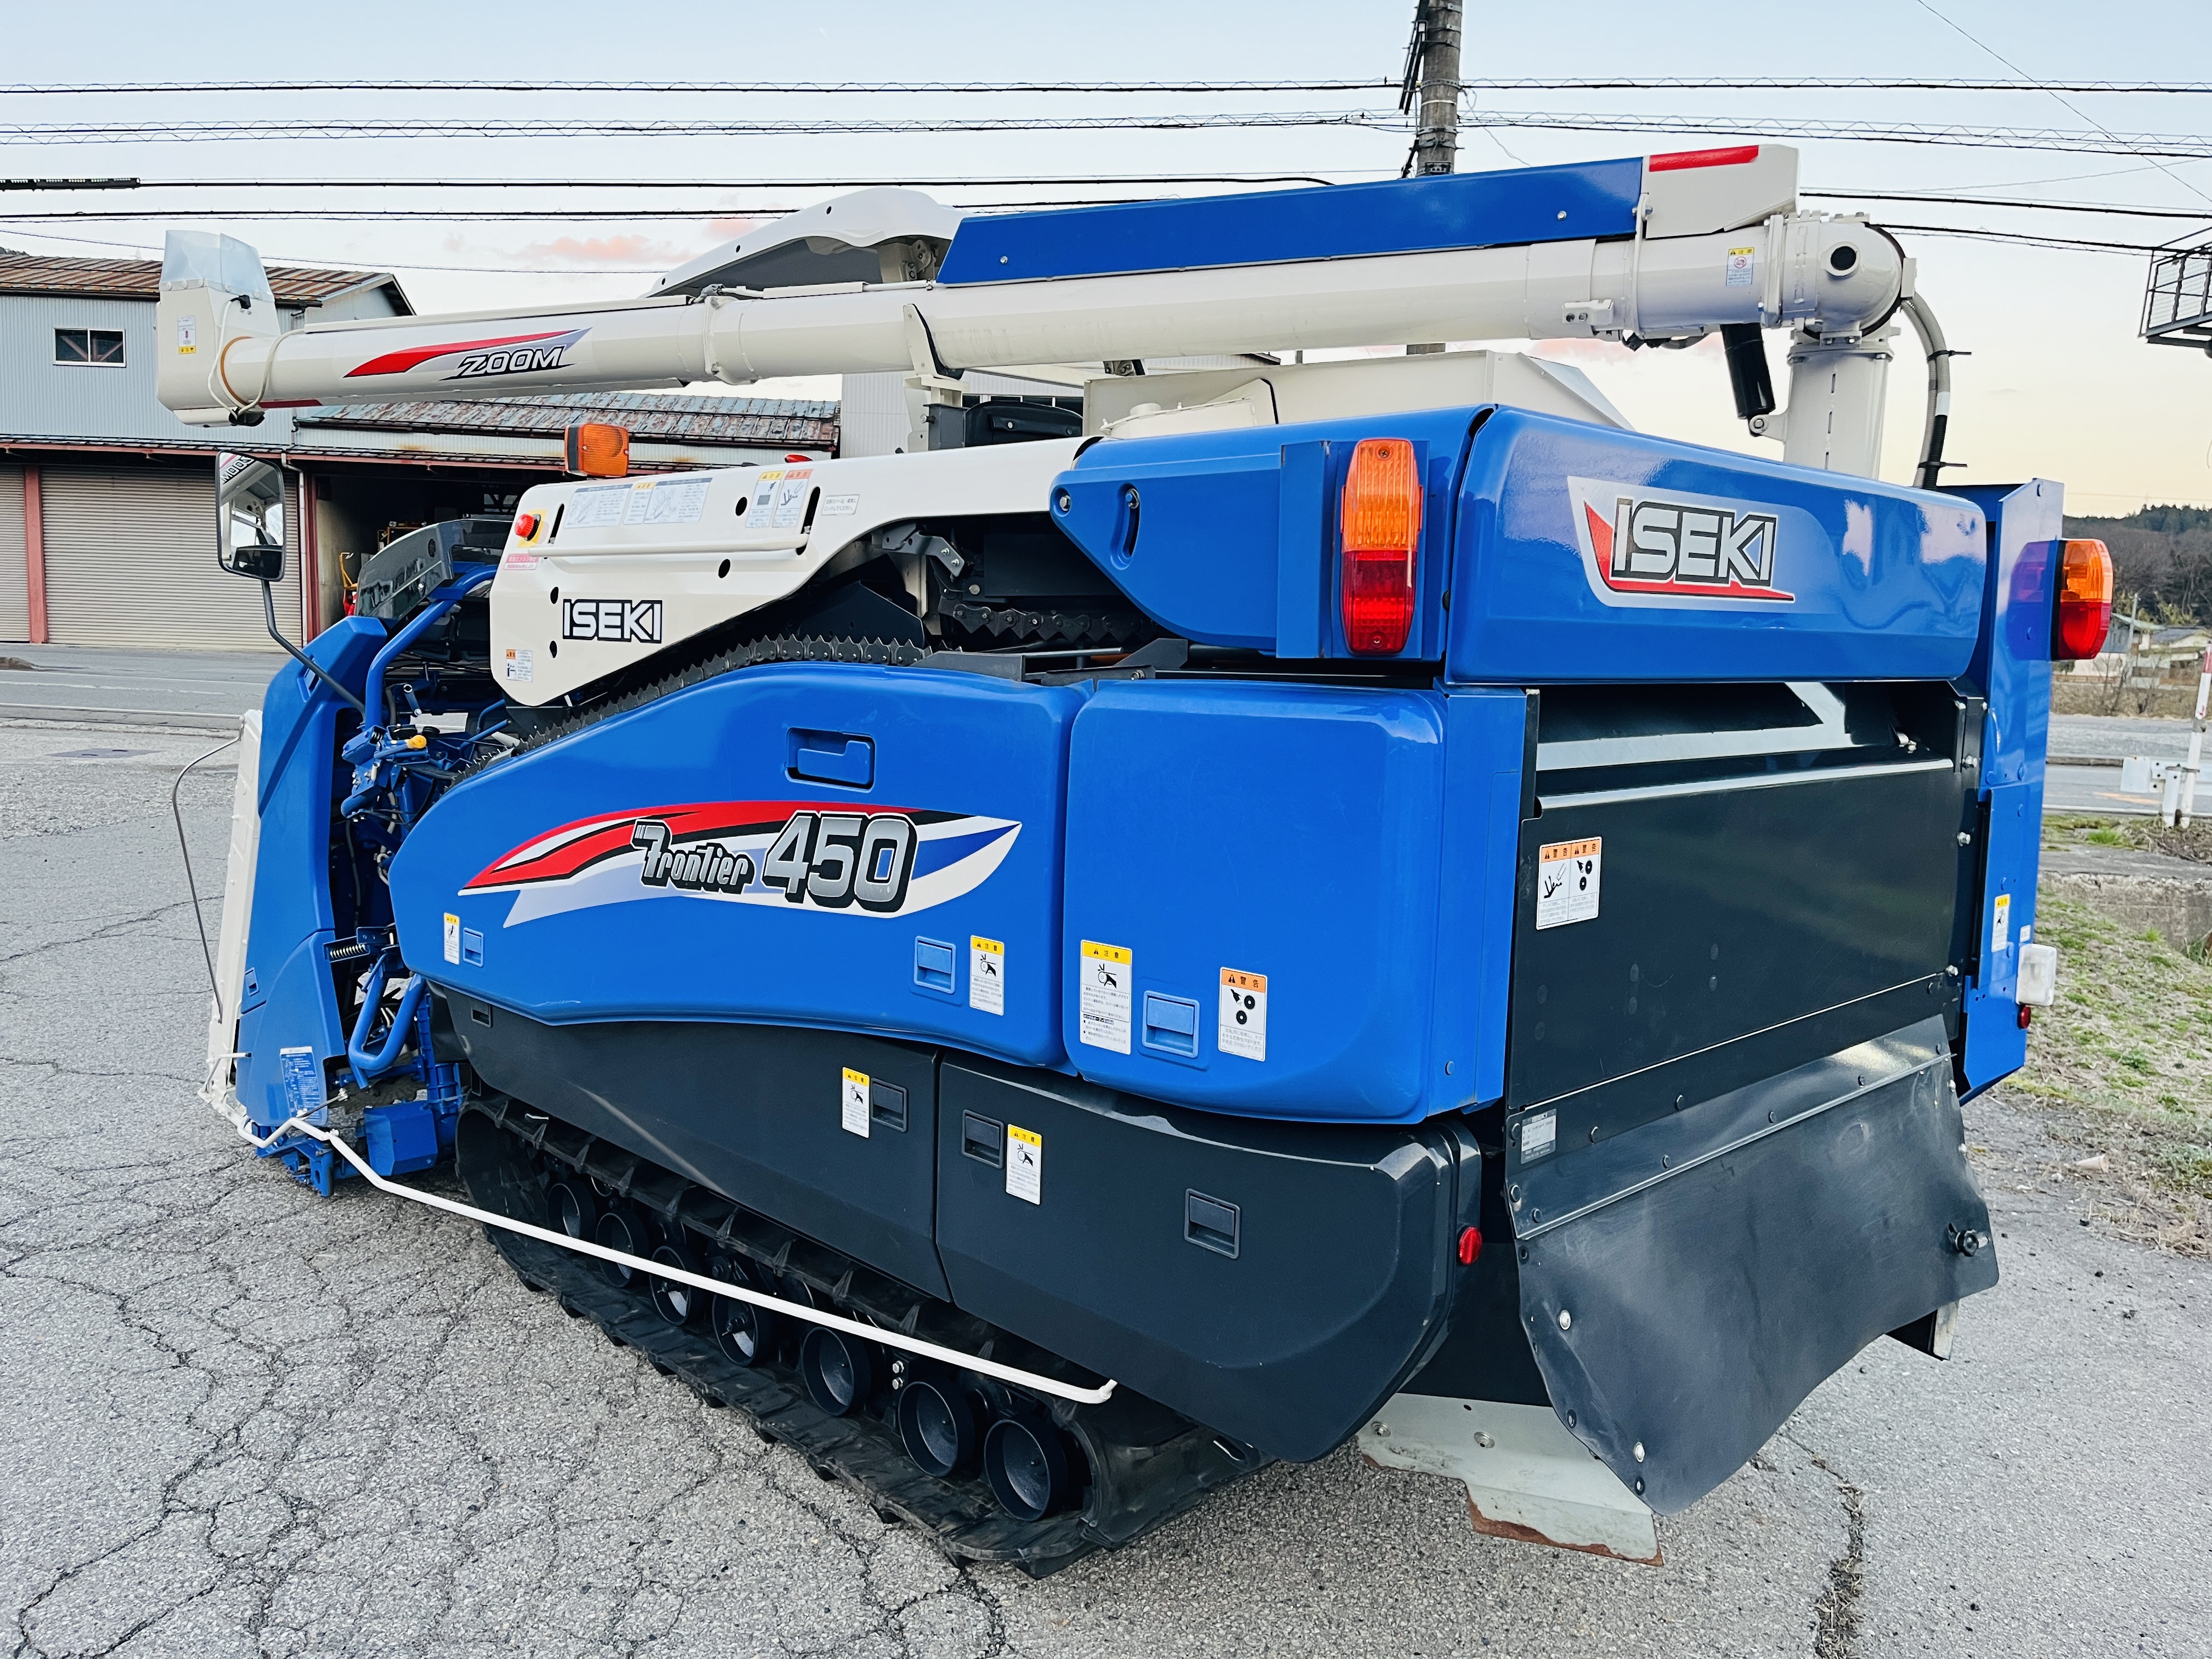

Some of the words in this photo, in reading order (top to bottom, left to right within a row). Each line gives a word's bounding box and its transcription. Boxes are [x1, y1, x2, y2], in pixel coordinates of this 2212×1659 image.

[456, 345, 566, 377] ZOOM
[1612, 498, 1777, 586] ISEKI
[563, 599, 662, 644] ISEKI
[632, 821, 754, 893] Frontier
[763, 813, 915, 909] 450
